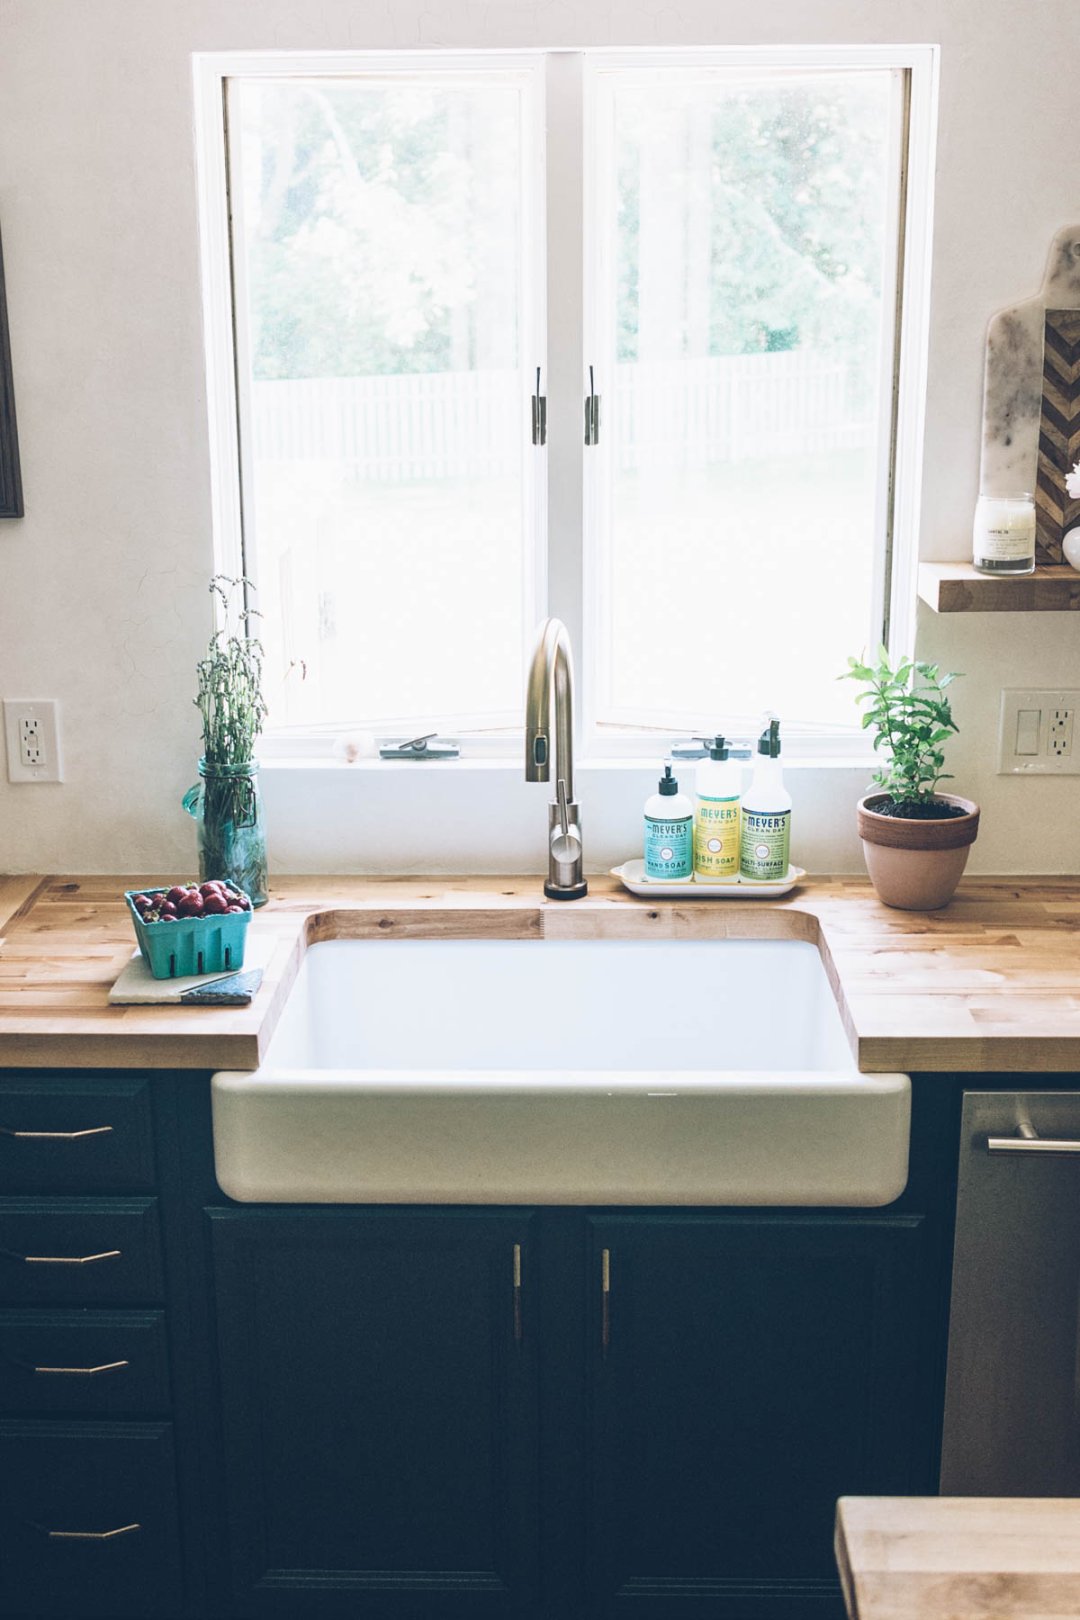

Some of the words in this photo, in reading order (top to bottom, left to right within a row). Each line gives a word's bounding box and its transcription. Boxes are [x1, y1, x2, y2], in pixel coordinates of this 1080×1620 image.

[700, 807, 737, 819] MEYER'S
[748, 816, 786, 828] MEYER'S
[652, 823, 688, 835] MEYER'S
[664, 861, 686, 869] SOAP
[715, 856, 735, 865] SOAP
